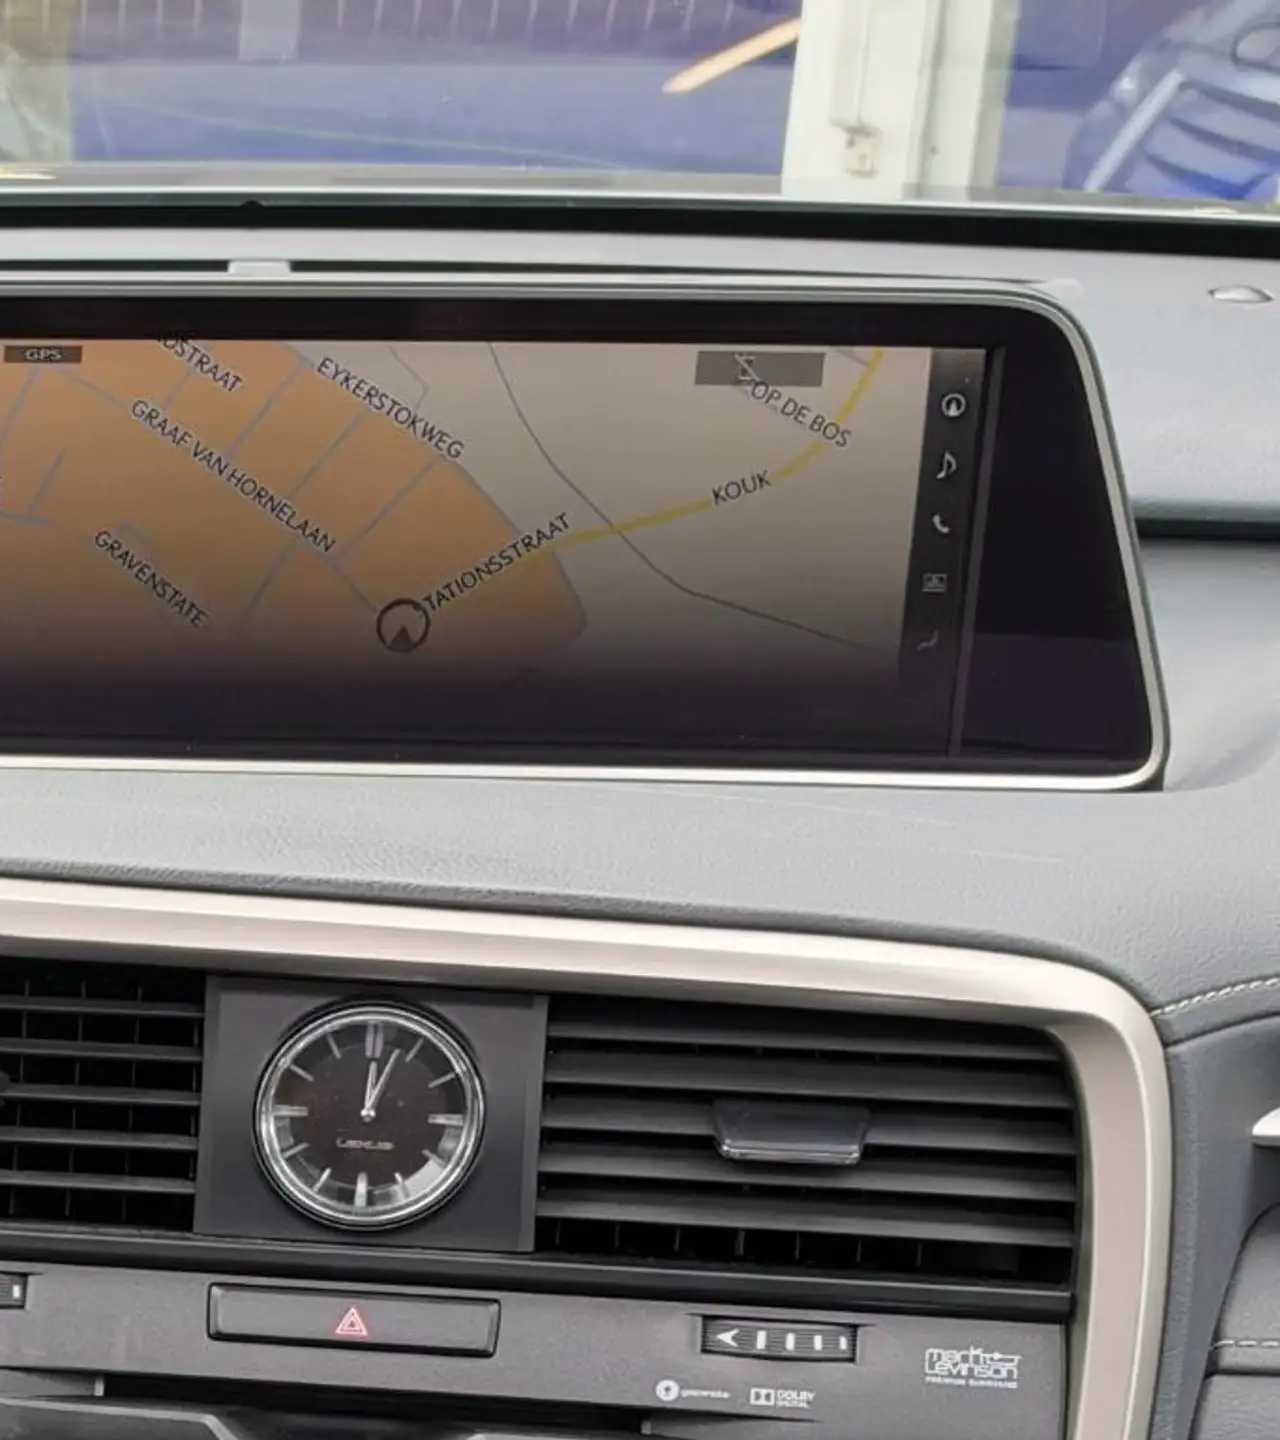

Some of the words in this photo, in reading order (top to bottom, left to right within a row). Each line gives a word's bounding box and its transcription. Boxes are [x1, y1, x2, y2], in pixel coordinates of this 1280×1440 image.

[25, 348, 62, 361] GPS
[317, 357, 465, 459] EYKERSTOKWEG
[750, 380, 781, 406] OP
[780, 397, 807, 425] DE
[808, 415, 852, 447] BOS
[131, 400, 192, 448] GRAAF
[191, 439, 229, 476] VAN
[226, 463, 337, 554] HORNELAAN
[94, 530, 210, 629] GRAVENSTATE
[414, 512, 571, 612] TATIONSSTRAAT
[776, 1389, 816, 1402] DOLBY
